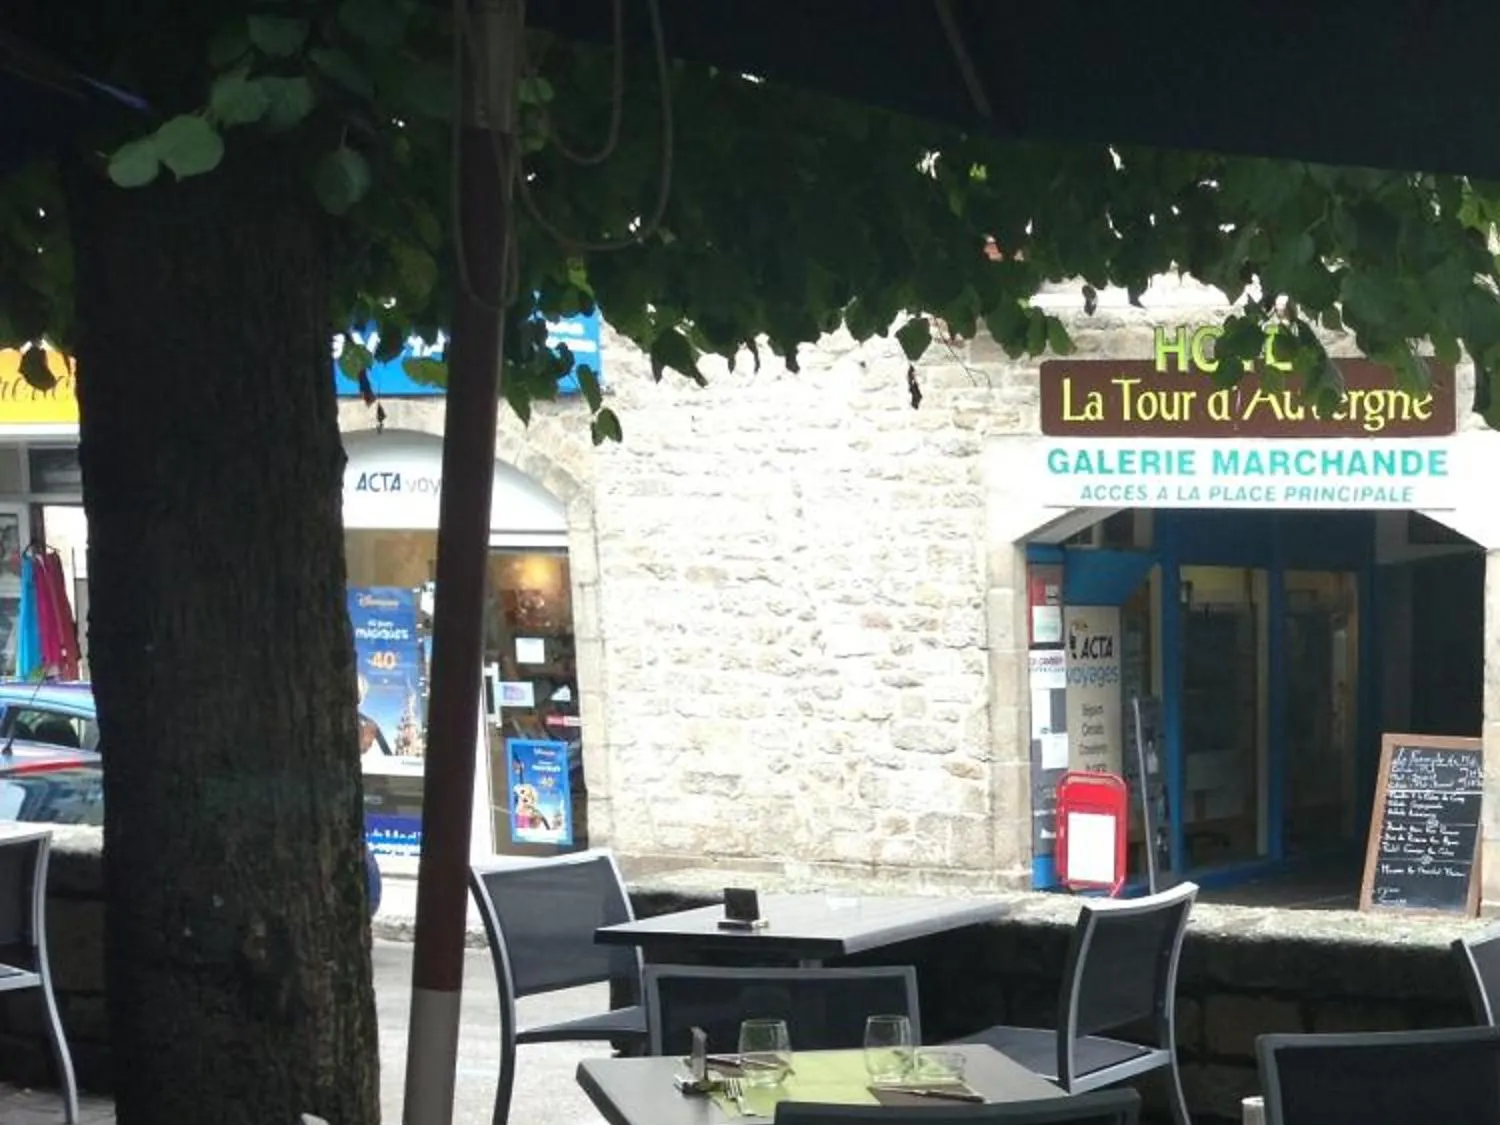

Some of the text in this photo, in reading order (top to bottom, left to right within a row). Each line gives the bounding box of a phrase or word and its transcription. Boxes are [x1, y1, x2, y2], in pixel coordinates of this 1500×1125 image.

[1062, 378, 1103, 422] La
[1111, 377, 1197, 422] Tour
[1047, 448, 1449, 477] GALERIE MARCHANDE
[355, 471, 401, 493] ACTA
[1156, 486, 1169, 501] A
[1176, 486, 1201, 501] LA
[1208, 486, 1276, 502] PLACE
[1284, 485, 1415, 502] PRINCIPALE
[1080, 635, 1113, 659] ACTA
